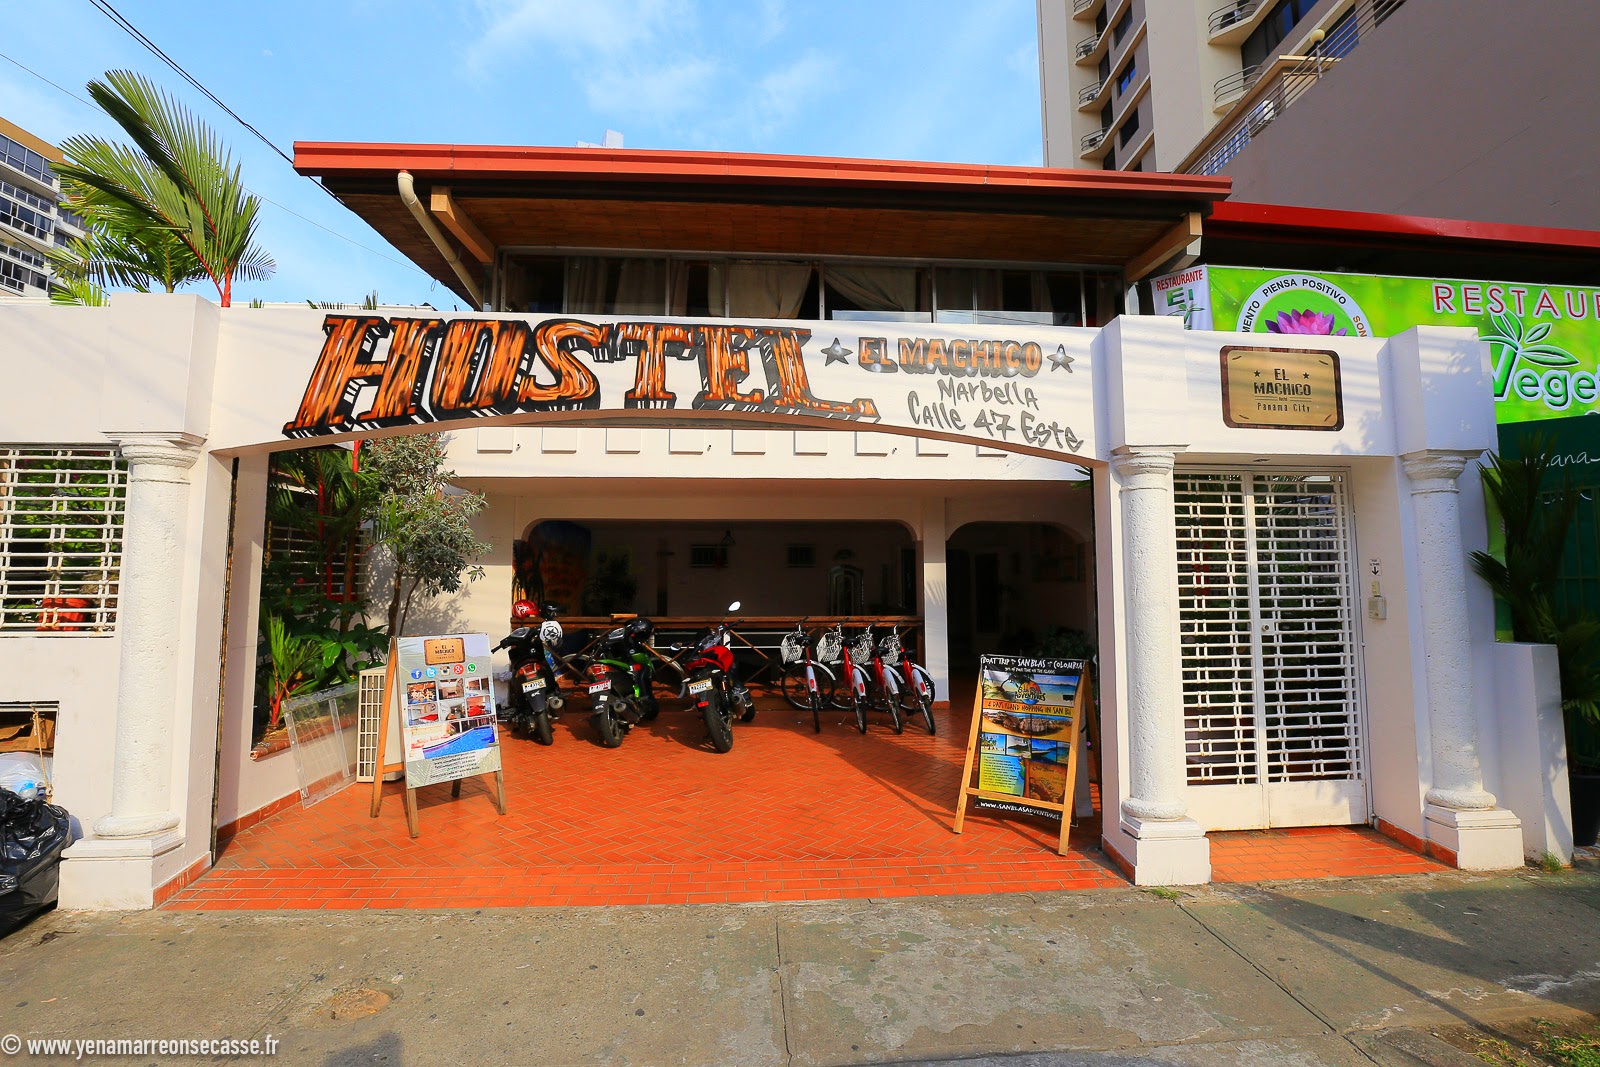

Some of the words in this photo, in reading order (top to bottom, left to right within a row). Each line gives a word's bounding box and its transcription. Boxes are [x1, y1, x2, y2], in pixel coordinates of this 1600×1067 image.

[1156, 269, 1203, 291] RESTAURANTE
[1262, 278, 1298, 297] PIENSA
[1302, 278, 1347, 305] POSITIVO
[1433, 284, 1600, 320] RESTAU
[858, 337, 898, 373] EL
[899, 337, 1042, 378] MACHICO
[282, 314, 880, 438] HOSTEL
[1274, 368, 1289, 381] EL
[1492, 345, 1600, 410] Vege
[937, 377, 1040, 411] Marbella
[1253, 382, 1312, 396] MACHICO
[1257, 402, 1288, 411] Panama
[1293, 403, 1310, 412] City
[907, 390, 966, 430] Calle
[973, 408, 1015, 440] 47
[1020, 410, 1084, 453] Este
[982, 656, 996, 665] BOAT
[1053, 660, 1083, 670] COLOMBIA
[1022, 704, 1044, 713] HOPPING
